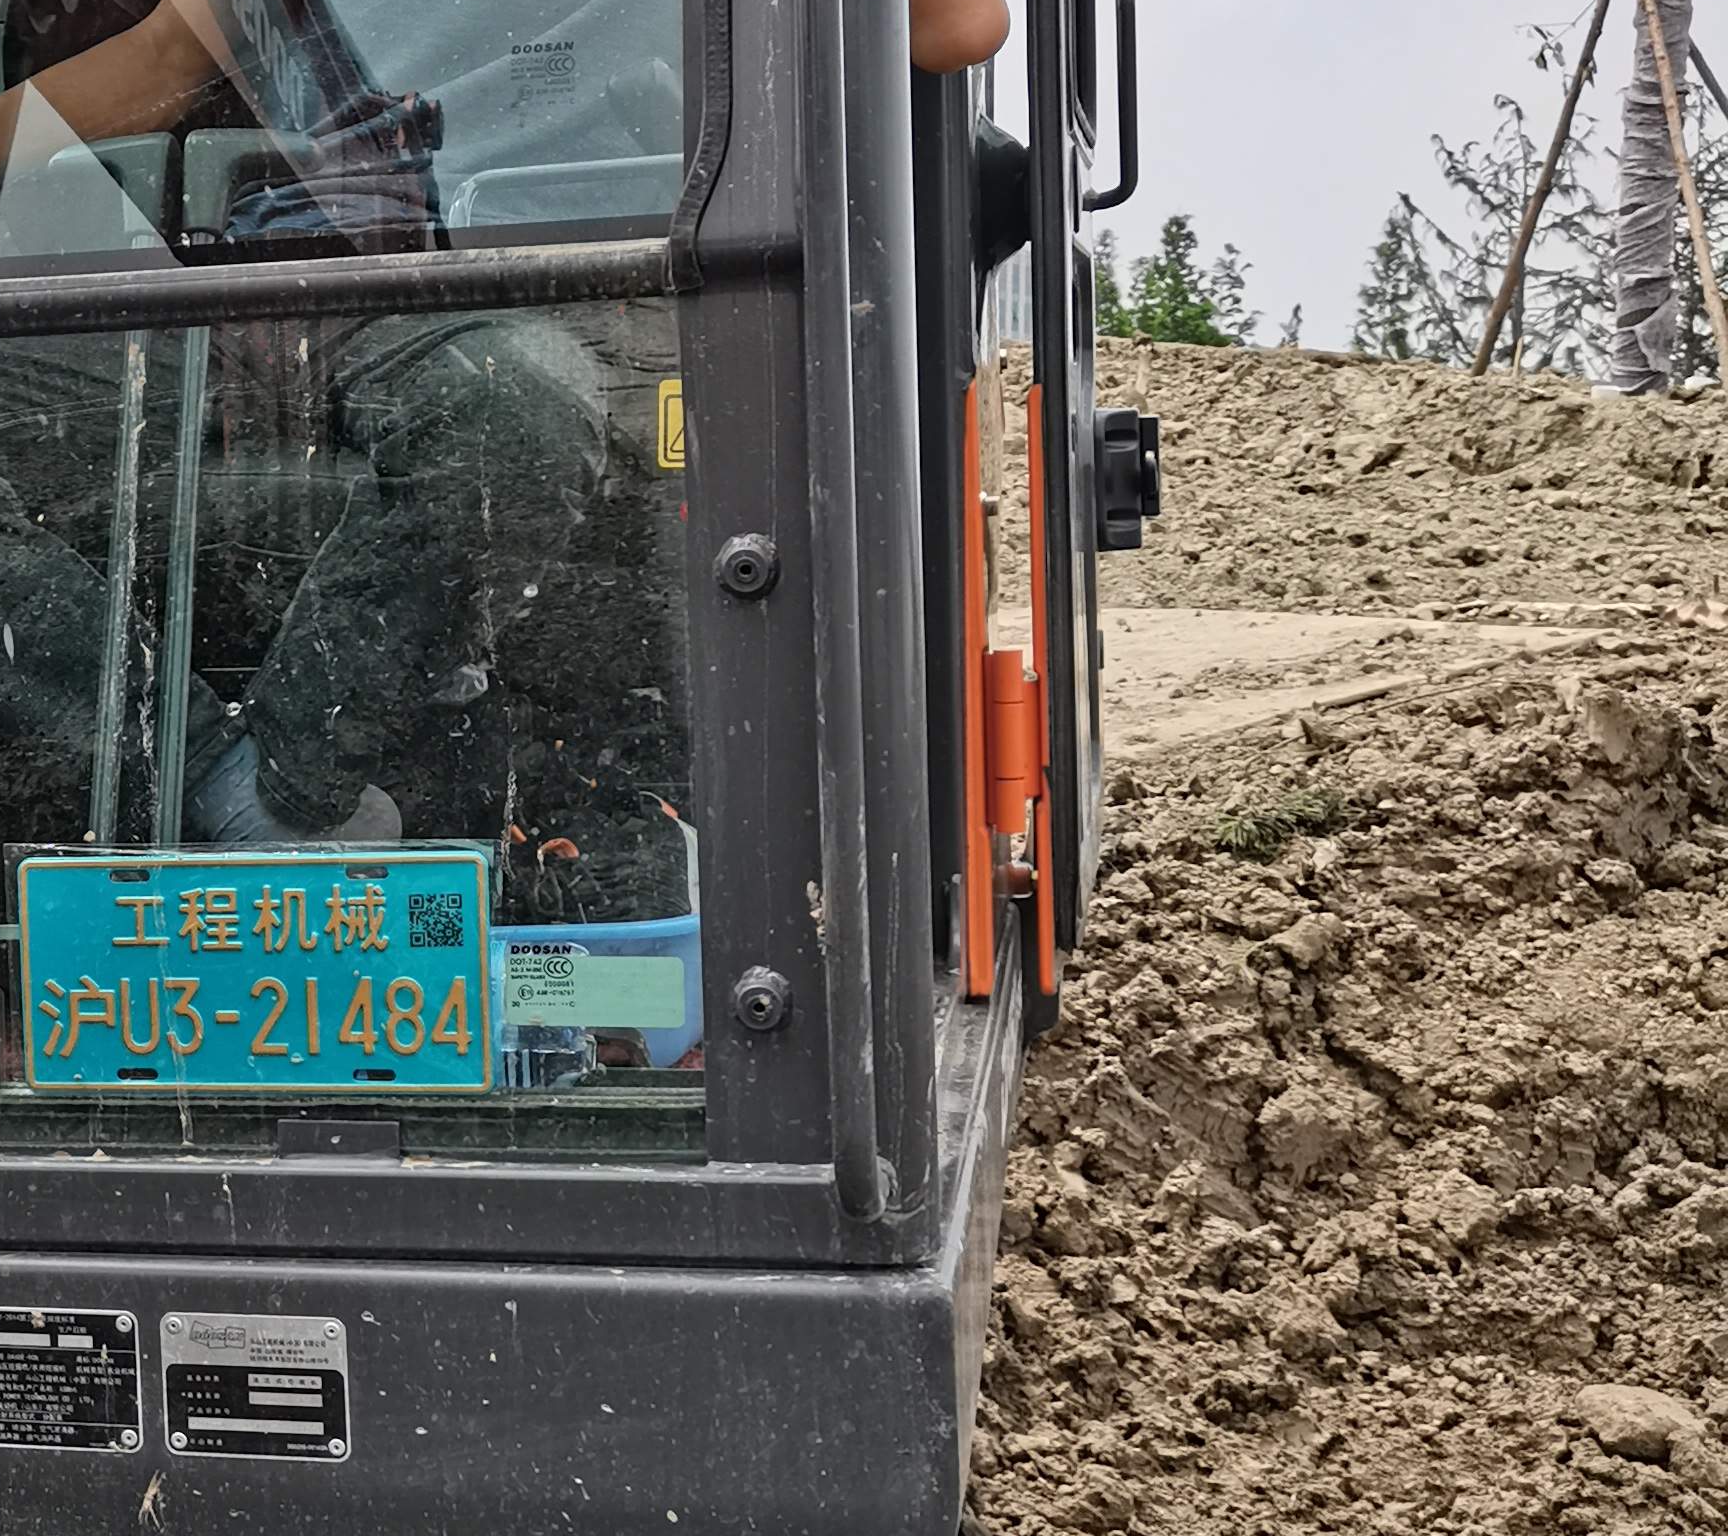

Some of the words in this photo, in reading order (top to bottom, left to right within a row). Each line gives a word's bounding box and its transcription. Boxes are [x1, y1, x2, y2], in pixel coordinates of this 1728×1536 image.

[511, 41, 574, 55] DOOSAN
[112, 885, 389, 953] 工程机械
[510, 945, 572, 955] DOOSAN
[41, 976, 472, 1059] 沪U3-21484
